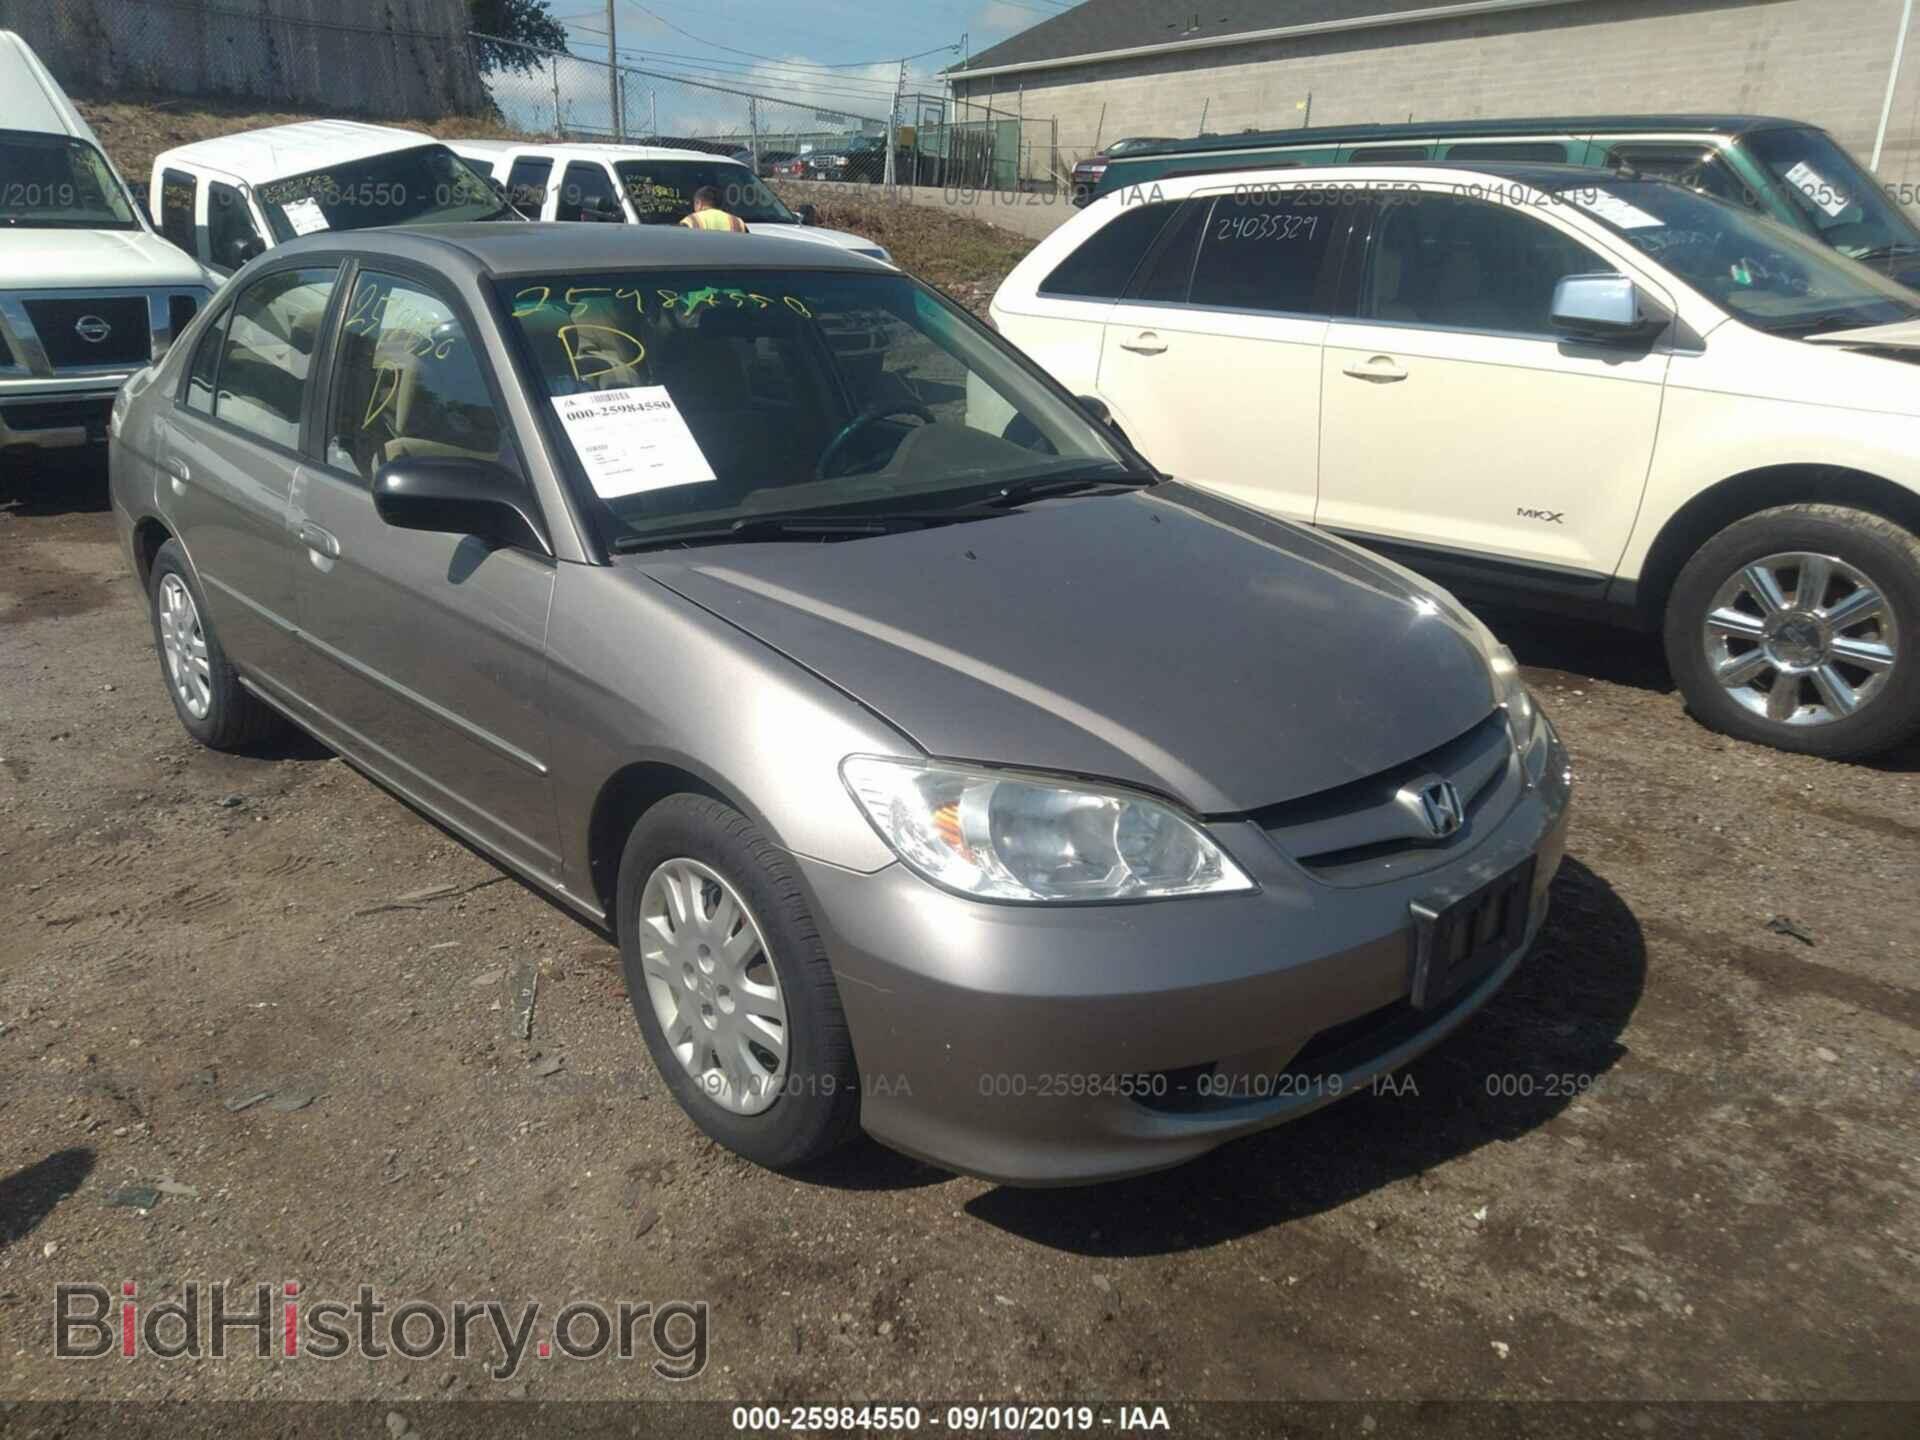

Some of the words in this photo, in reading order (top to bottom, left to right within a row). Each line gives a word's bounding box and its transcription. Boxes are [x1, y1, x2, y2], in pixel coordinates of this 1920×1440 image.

[1217, 213, 1318, 241] 24035329
[566, 401, 671, 421] 000-25984550
[1516, 507, 1564, 524] MKX
